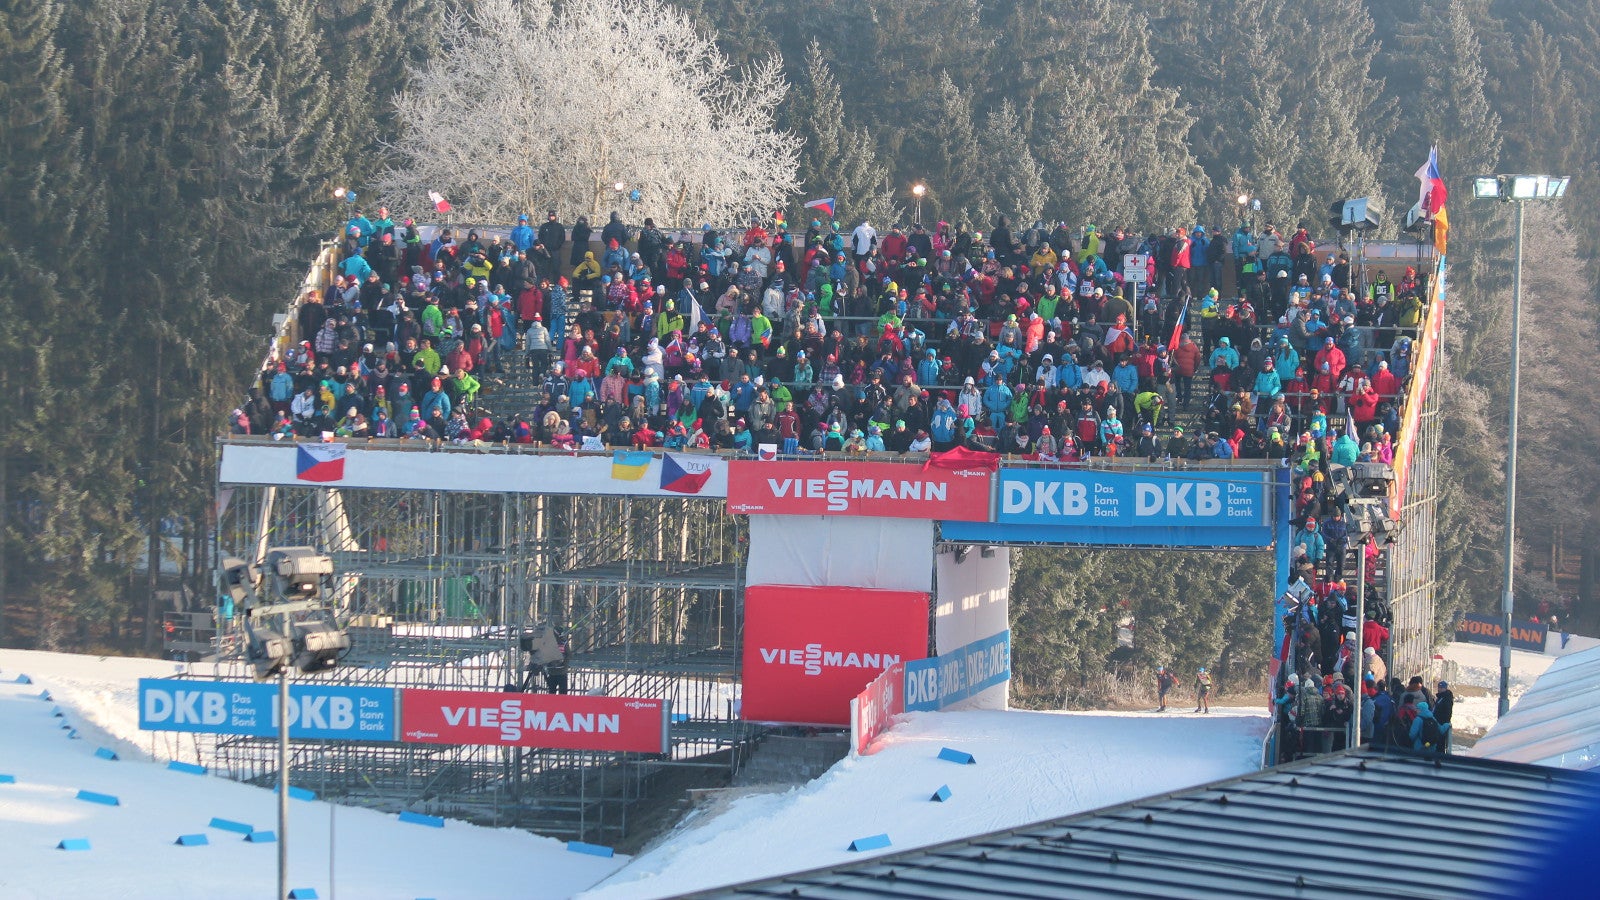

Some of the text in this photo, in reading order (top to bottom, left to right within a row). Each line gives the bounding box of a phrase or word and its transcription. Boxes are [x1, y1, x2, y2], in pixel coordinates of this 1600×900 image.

[767, 470, 947, 511] VIESSMANN
[1094, 483, 1114, 493] Das
[1227, 483, 1247, 494] Das
[1002, 480, 1089, 516] DKB
[1094, 495, 1119, 505] kann
[1135, 482, 1222, 517] DKB
[1227, 496, 1252, 505] kann
[1094, 507, 1119, 517] Bank
[1227, 507, 1253, 517] Bank
[760, 643, 900, 676] VIESSMANN
[908, 668, 938, 705] DKB
[943, 660, 960, 697] DKB
[967, 650, 984, 686] DKB
[231, 693, 251, 704] Das
[359, 697, 379, 708] Das
[144, 689, 228, 725] DKB
[231, 705, 256, 715] kann
[271, 694, 355, 730] DKB
[359, 710, 384, 719] kann
[441, 699, 619, 741] VIESSMANN
[231, 717, 256, 727] Bank
[359, 721, 384, 731] Bank
